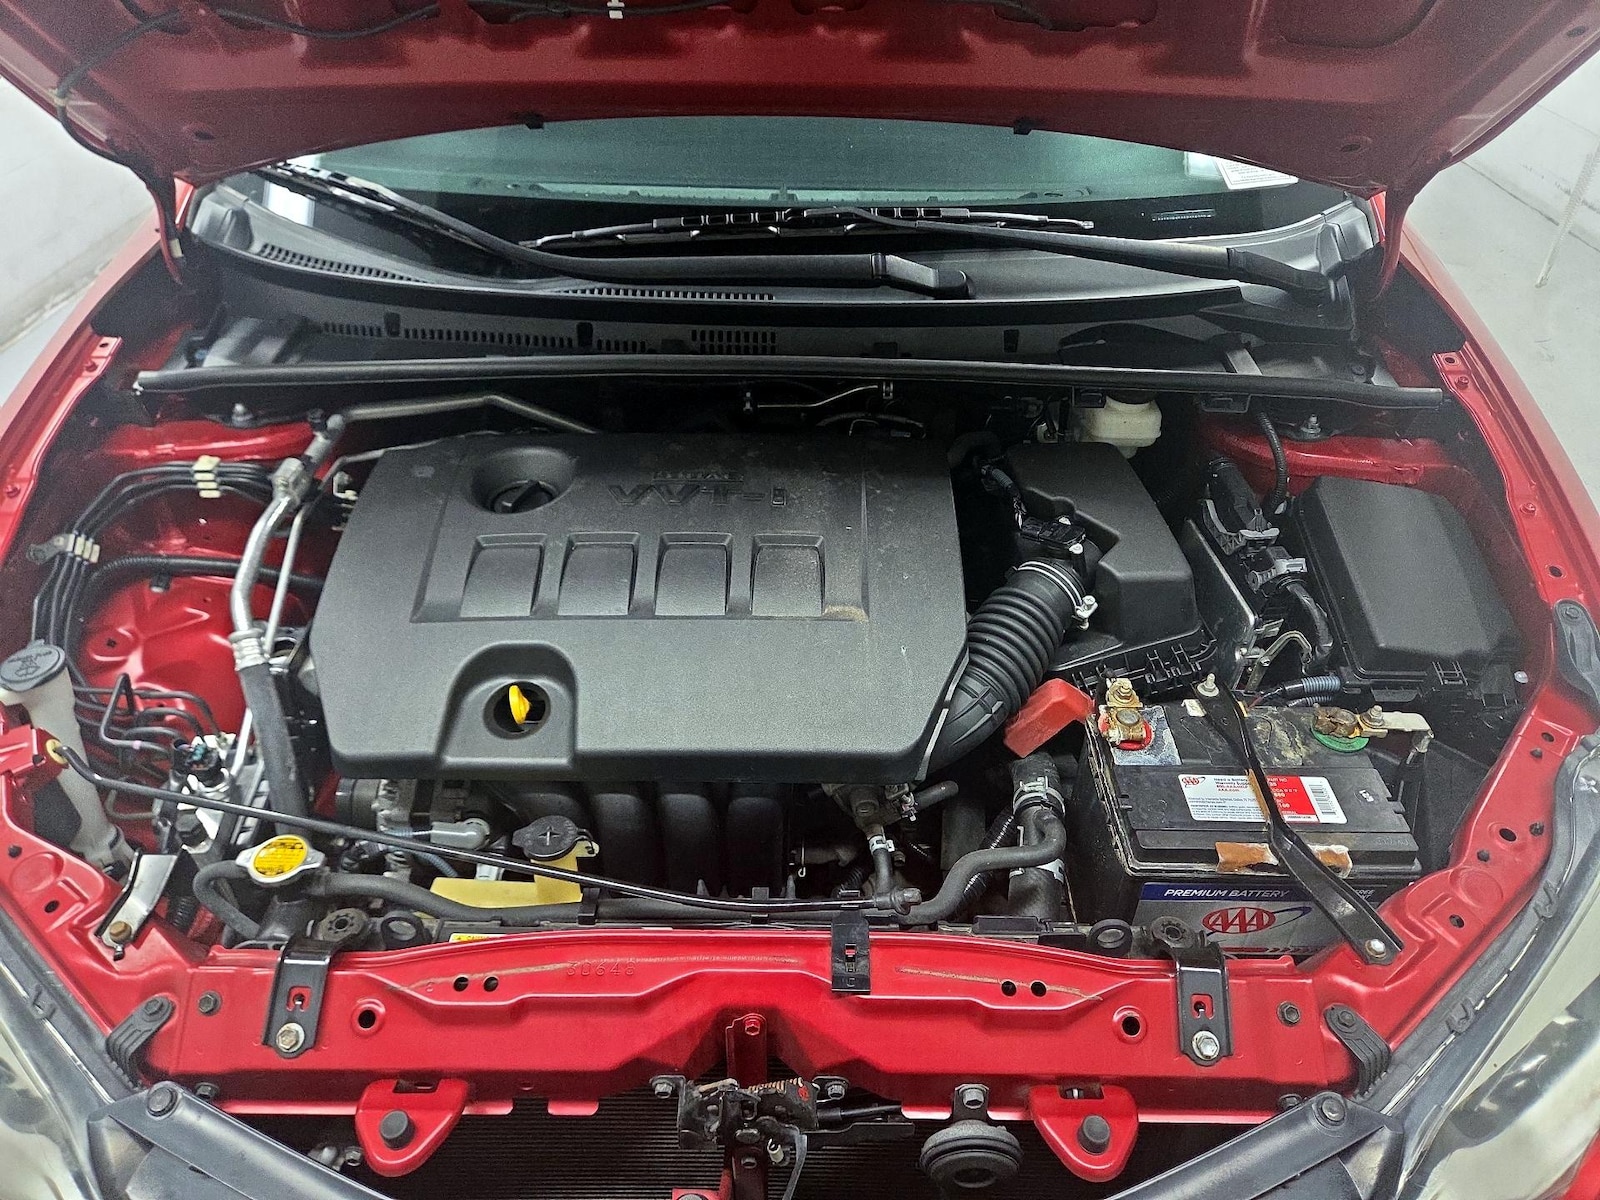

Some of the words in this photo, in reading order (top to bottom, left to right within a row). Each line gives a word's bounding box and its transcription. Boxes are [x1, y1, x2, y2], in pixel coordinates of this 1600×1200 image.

[1164, 888, 1227, 897] PREMIUM
[1229, 889, 1290, 898] BATTERY
[1207, 907, 1267, 933] AAA
